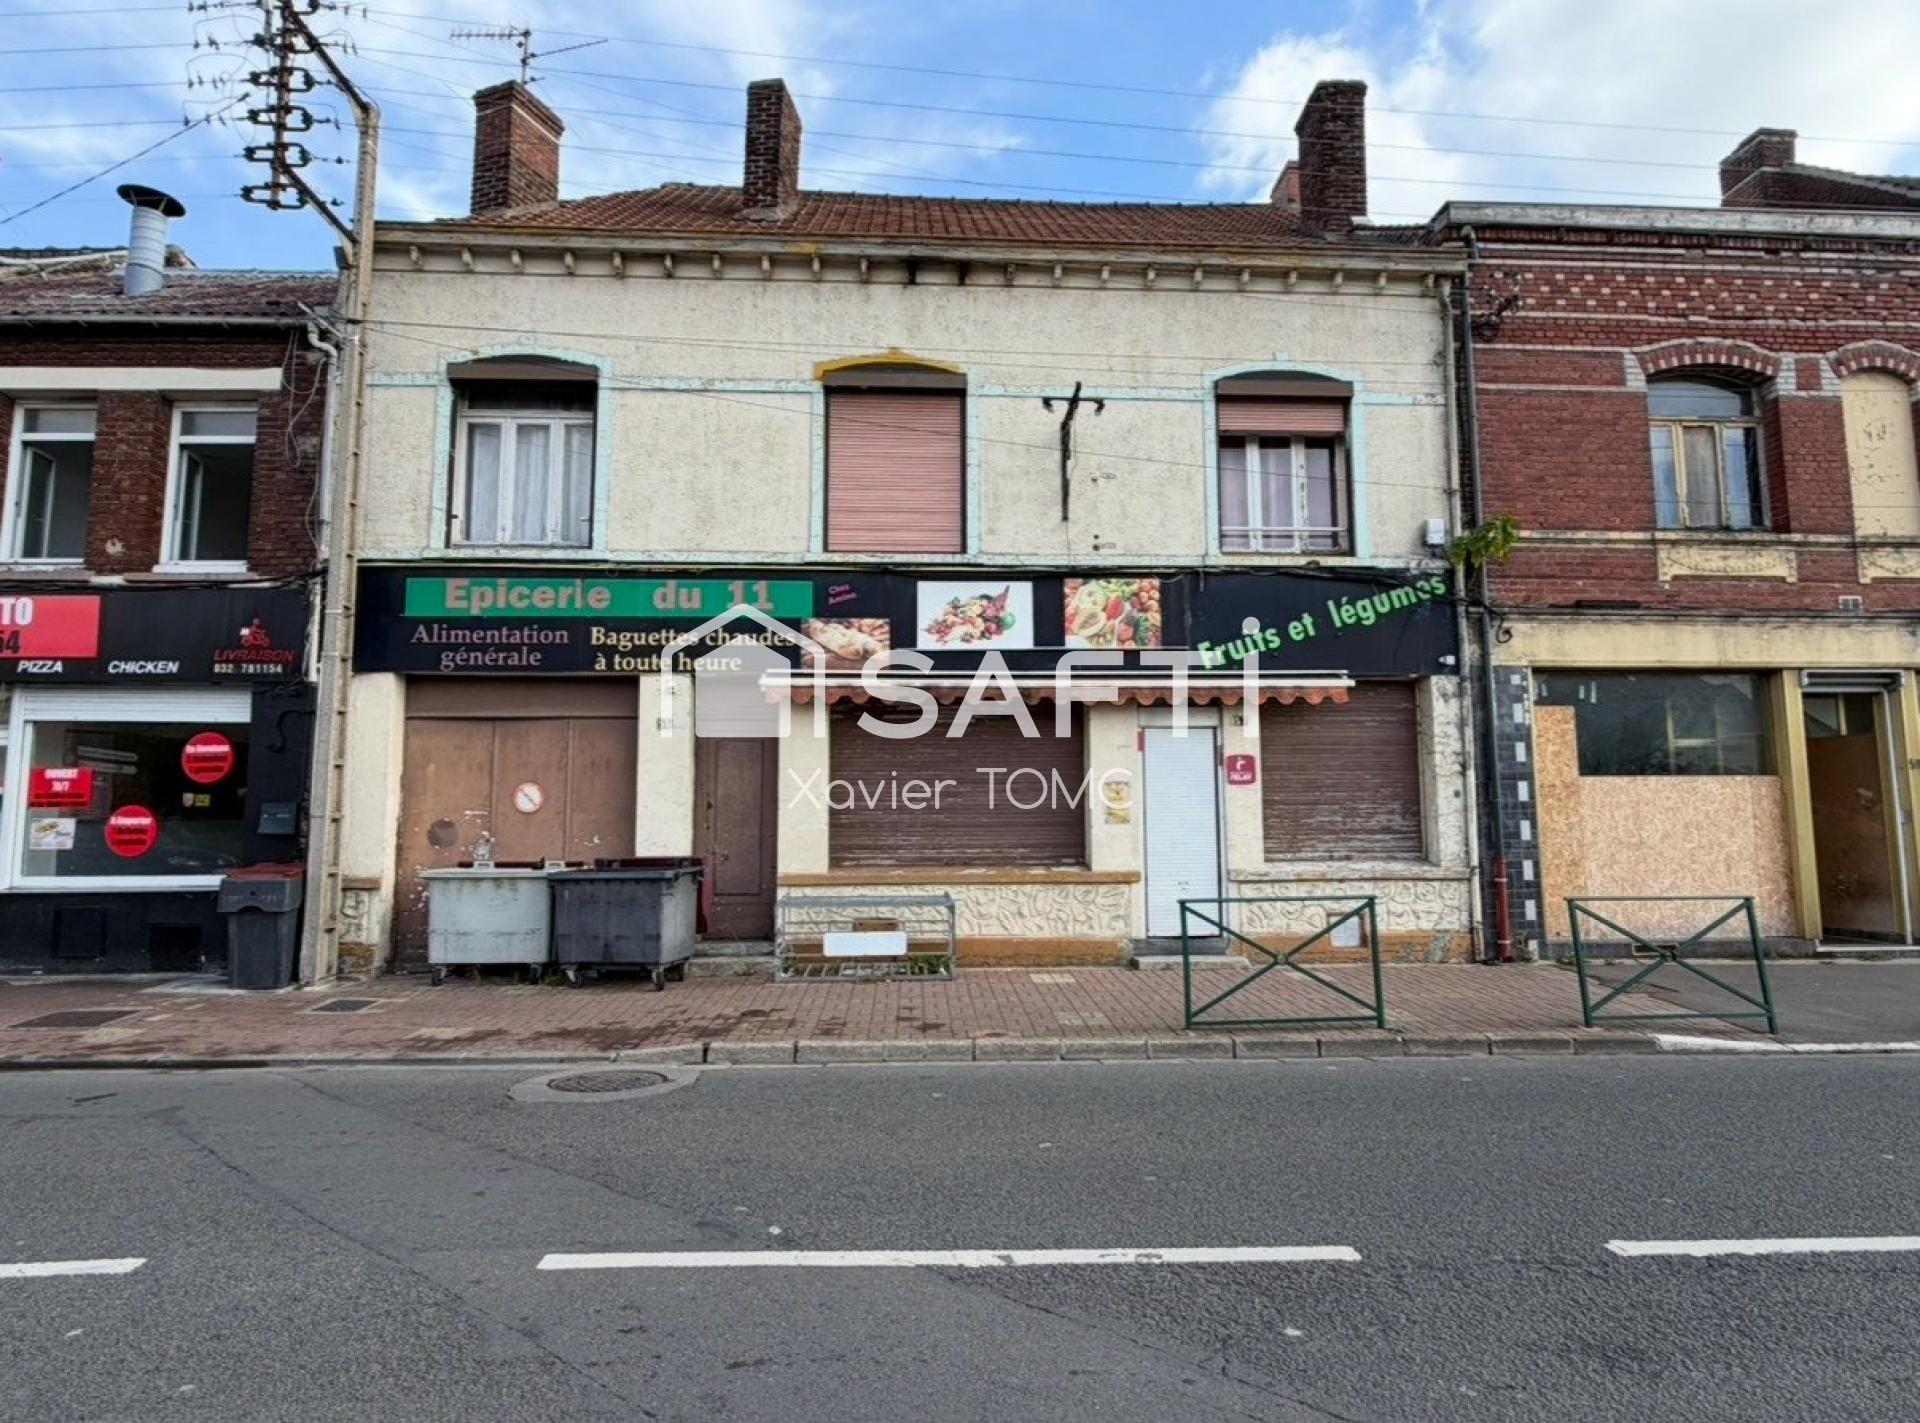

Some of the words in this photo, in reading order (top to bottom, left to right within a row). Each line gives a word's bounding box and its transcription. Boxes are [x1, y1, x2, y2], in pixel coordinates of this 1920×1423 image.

[445, 578, 612, 616] Epicerie
[653, 579, 702, 611] du
[727, 580, 774, 611] 11
[1197, 627, 1281, 669] Fruits
[1287, 611, 1317, 641] et
[1327, 575, 1448, 627] légumes
[411, 623, 569, 645] Alimentation
[590, 626, 699, 651] Baguettes
[705, 626, 797, 647] chaudes
[17, 659, 63, 673] PIZZA
[213, 649, 297, 661] LIVRAISON
[440, 646, 543, 673] générale
[594, 652, 607, 671] à
[614, 655, 672, 671] toute
[678, 651, 743, 672] heure
[107, 660, 180, 675] CHICKEN
